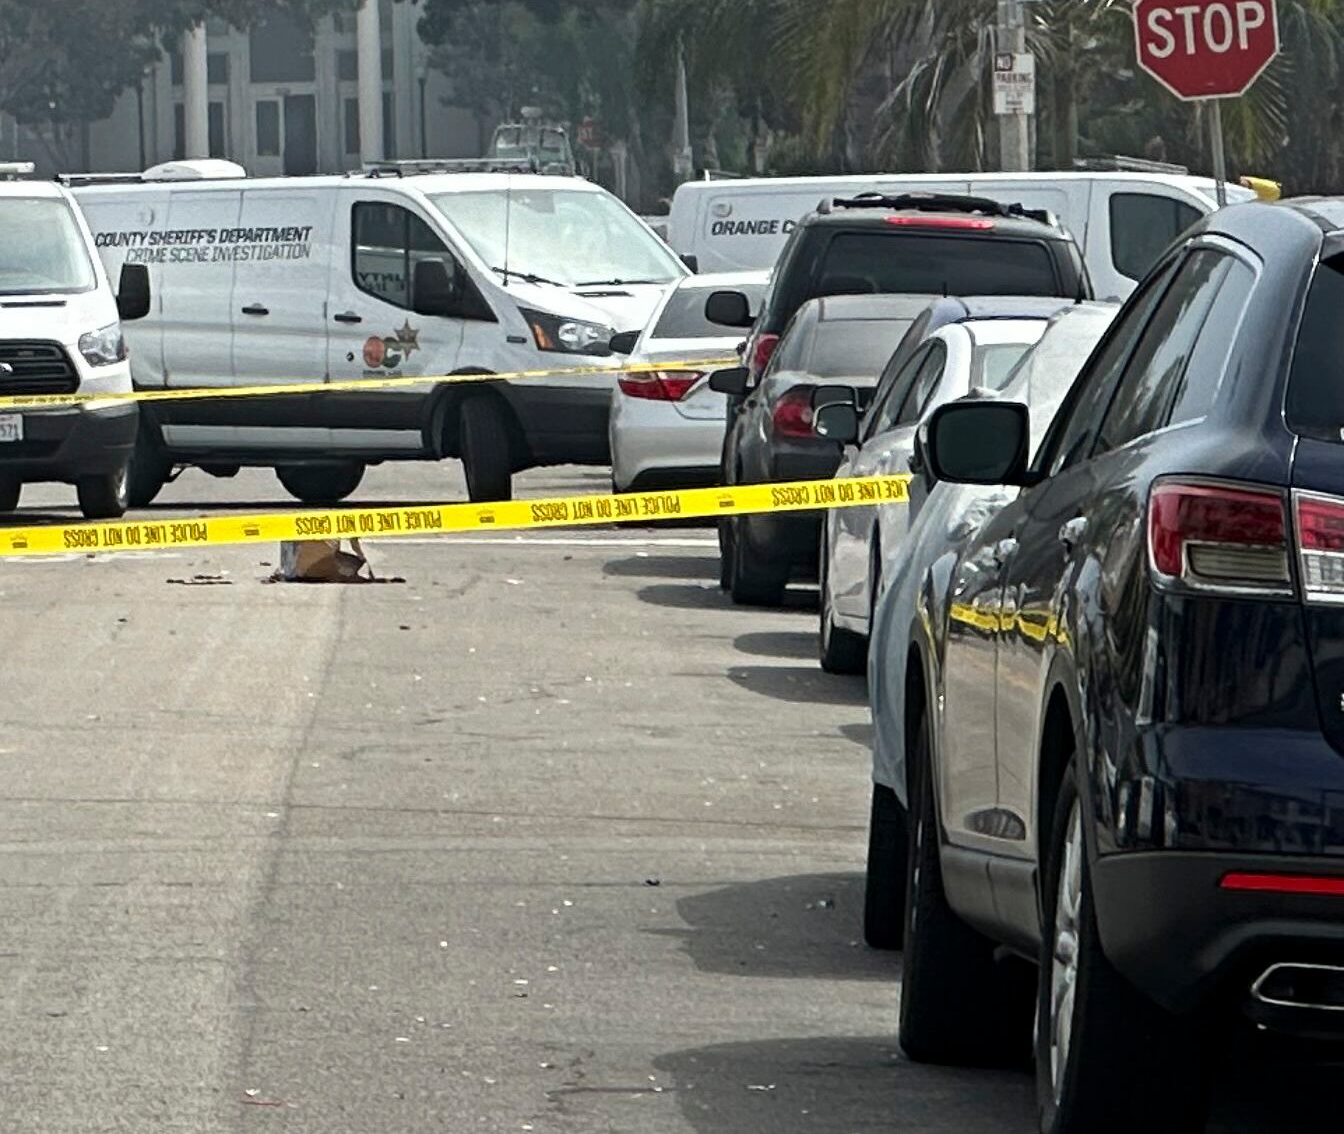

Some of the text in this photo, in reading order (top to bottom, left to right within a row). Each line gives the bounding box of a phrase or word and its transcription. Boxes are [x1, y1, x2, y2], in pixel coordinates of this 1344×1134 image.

[1147, 0, 1265, 59] STOP
[95, 226, 313, 247] COUNTY SHERIFF'S DEPARTMENT
[711, 219, 780, 236] ORANGE
[126, 244, 312, 263] CRIME SCENE INVESTIGATION
[772, 486, 810, 505] CROSS
[814, 485, 835, 503] NOT
[838, 483, 854, 501] DO
[858, 481, 882, 499] LINE
[532, 496, 681, 521] POLICE LINE DO NOT CROSS
[296, 511, 442, 534] POLICE LINE DO NOT CROSS
[63, 523, 208, 547] POLICE LINE DO NOT CROSS
